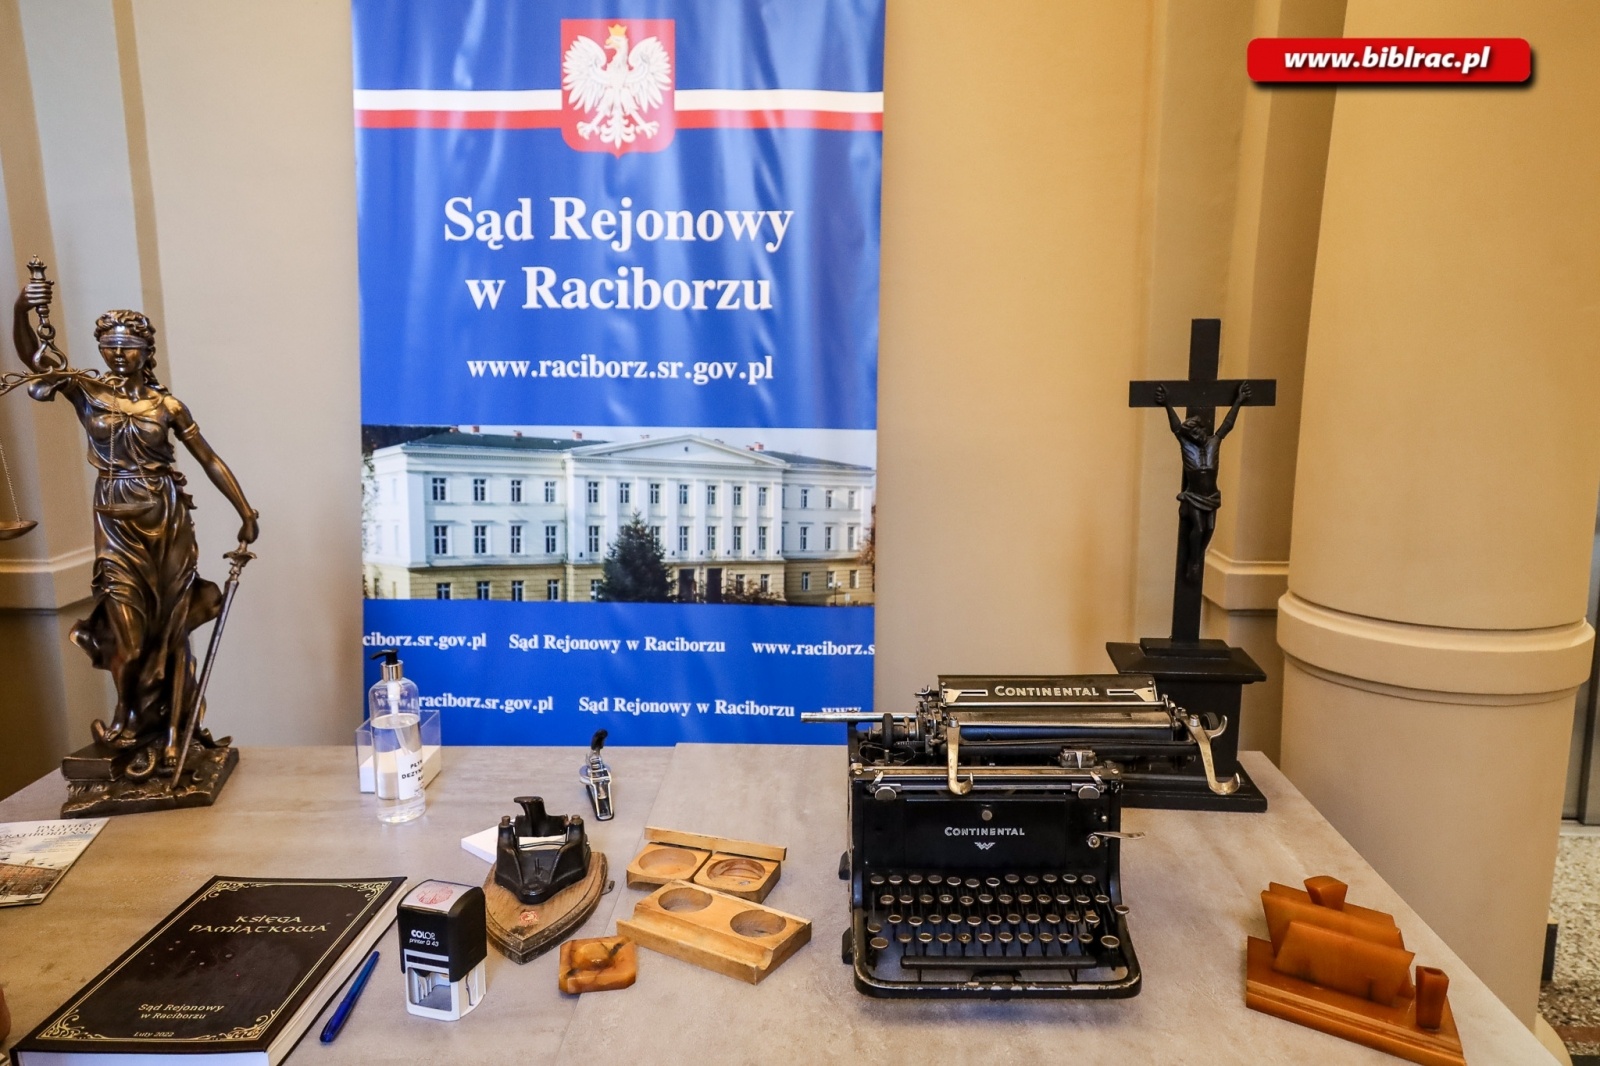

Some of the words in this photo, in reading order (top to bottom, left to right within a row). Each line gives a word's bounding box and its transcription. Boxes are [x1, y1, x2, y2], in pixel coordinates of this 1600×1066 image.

[444, 197, 534, 250] Sąd
[550, 197, 795, 253] Rejonowy
[465, 279, 505, 310] w
[522, 266, 773, 311] Raciborzu
[467, 354, 773, 385] www.raciborz.sr.gov.pl
[509, 634, 539, 652] Sąd
[543, 634, 621, 654] Rejonowy
[626, 640, 640, 650] w
[644, 636, 726, 653] Raciborzu
[752, 640, 874, 656] www.raciborz.s
[994, 685, 1100, 697] CONTINENTAL
[579, 697, 609, 715] Sąd
[613, 697, 692, 717] Rejonowy
[696, 703, 710, 713] w
[715, 699, 795, 717] Raciborzu
[944, 826, 1026, 837] CONTINENTAL
[235, 915, 302, 924] KSIĘGA
[188, 924, 328, 935] PAMIĄTKOWA
[138, 1004, 163, 1012] Sąd
[163, 1004, 225, 1012] Rejonowy
